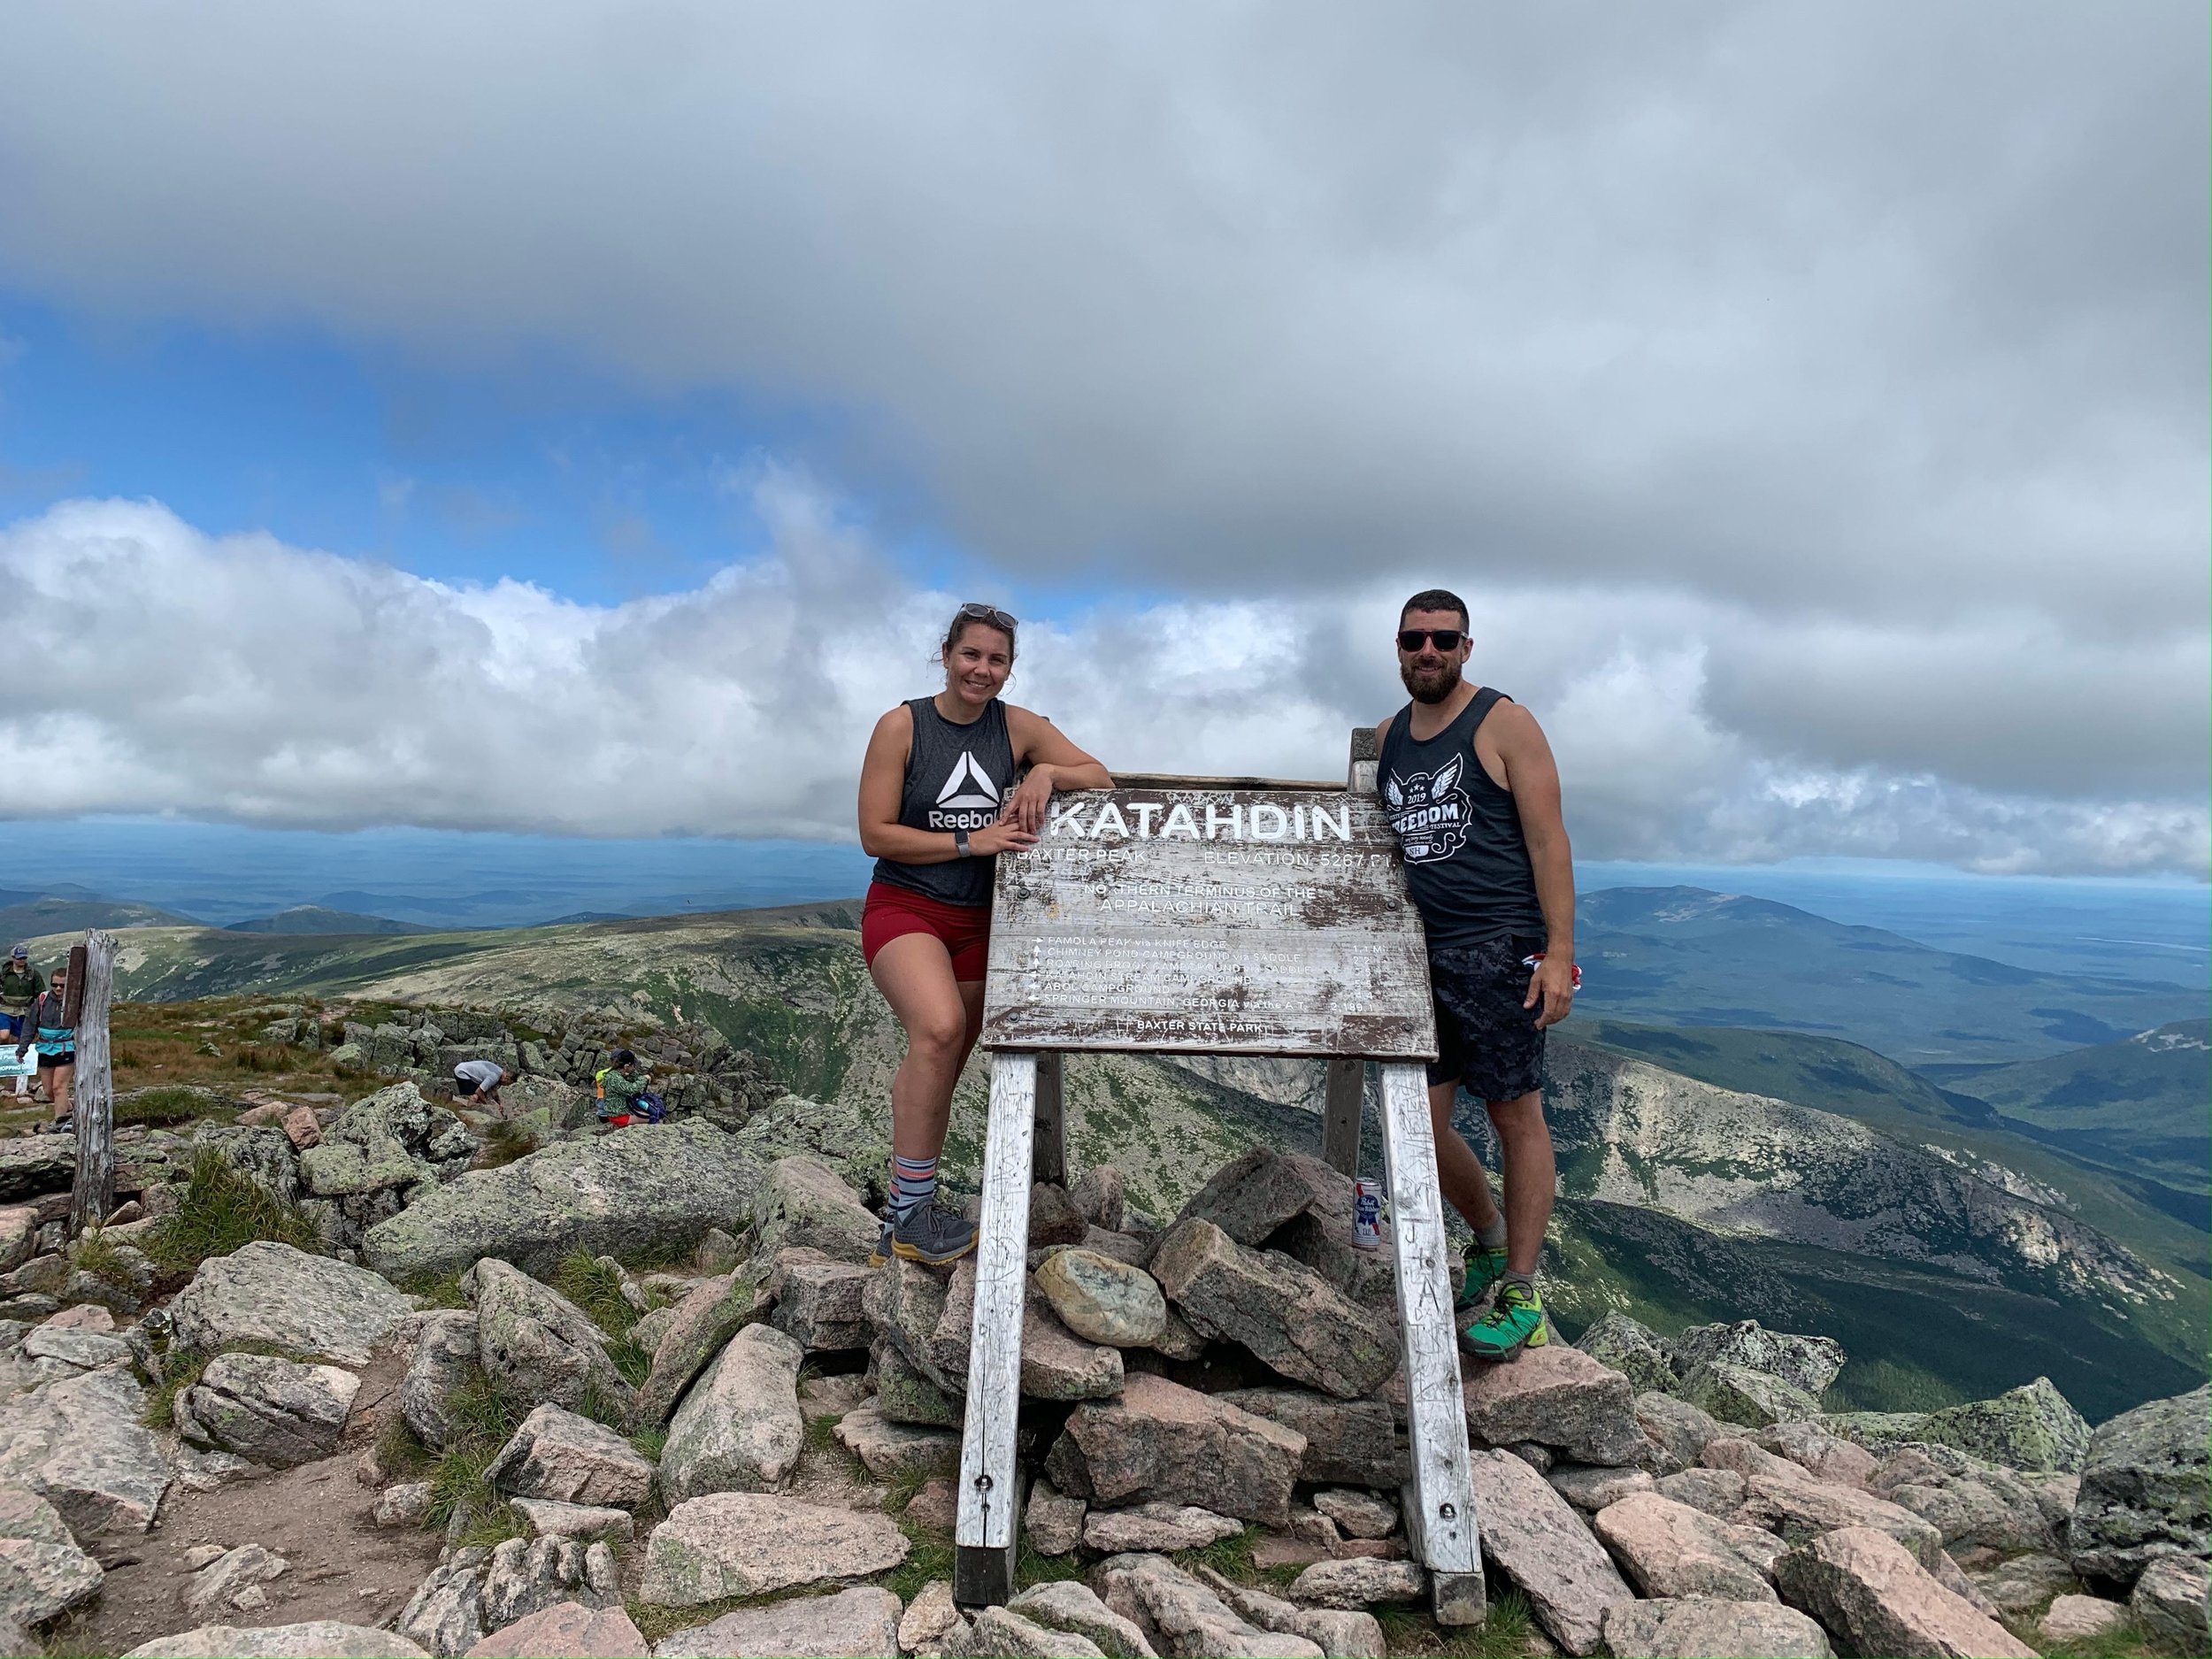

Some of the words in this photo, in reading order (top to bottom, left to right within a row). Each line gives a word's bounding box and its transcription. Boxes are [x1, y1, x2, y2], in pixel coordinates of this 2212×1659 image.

[1408, 793, 1426, 804] 2019
[1050, 801, 1350, 841] KATAHDIN
[1018, 849, 1089, 861] BAXTER
[1096, 849, 1147, 863] PEAK
[1204, 851, 1309, 865] ELEVATION
[1320, 854, 1363, 866] 5267
[1408, 847, 1421, 856] NH
[1177, 885, 1255, 898] TERMINUS
[1260, 887, 1281, 898] OF
[1285, 887, 1316, 900] THE
[1100, 899, 1238, 915] APPALACHIAN
[1246, 902, 1300, 917] TRAIL
[1048, 936, 1096, 945] PAMOLA
[1100, 938, 1132, 947] PEAK
[1135, 938, 1151, 947] via
[1155, 939, 1190, 948] KNIFE
[1194, 940, 1227, 949] EDGE
[1047, 948, 1102, 957] CHIMNEY
[1142, 950, 1230, 960] CAMPGROUND
[1253, 952, 1301, 962] SADDLE
[1047, 959, 1102, 969] ROARING
[1105, 961, 1148, 970] BROOK
[1046, 972, 1107, 980] KATAHDIN
[1164, 974, 1252, 984] CAMPGROUND
[1044, 982, 1078, 992] ABOL
[1081, 984, 1170, 994] CAMPGROUND
[1044, 994, 1107, 1004] SPRINGER
[1183, 998, 1240, 1008] GEORGIA
[1243, 999, 1260, 1009] via
[1263, 1000, 1282, 1009] the
[1137, 1020, 1185, 1030] BAXTER
[1189, 1021, 1225, 1032] STATE
[1230, 1022, 1263, 1033] PARK
